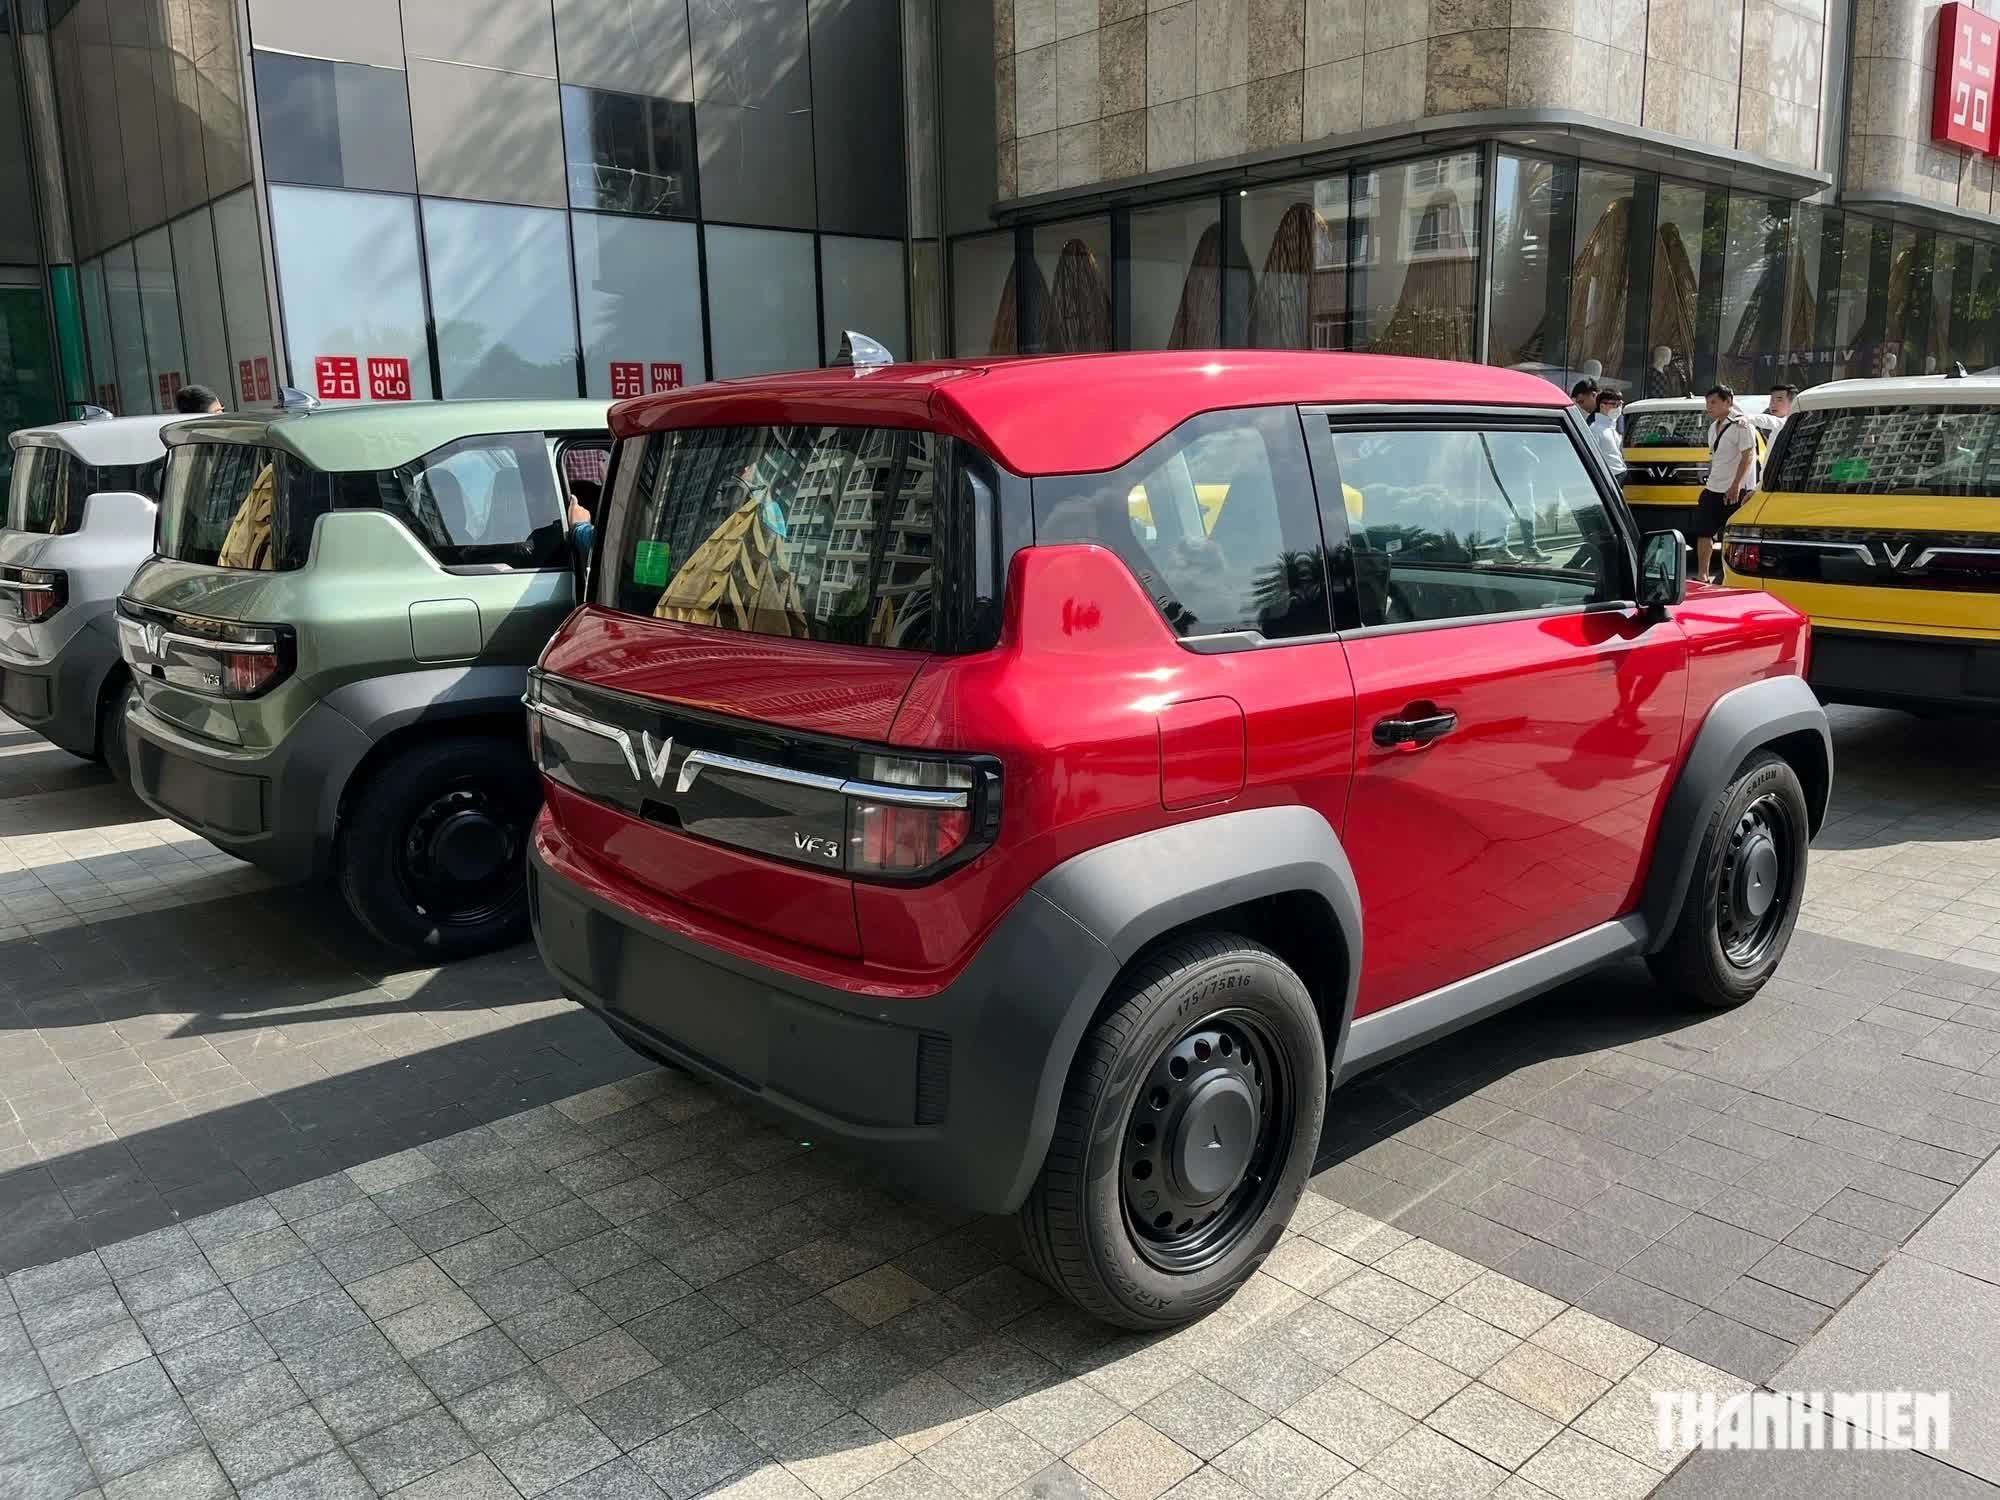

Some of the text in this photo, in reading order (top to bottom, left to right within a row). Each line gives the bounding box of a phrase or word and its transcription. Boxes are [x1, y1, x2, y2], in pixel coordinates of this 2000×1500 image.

[322, 361, 353, 377] ユニ
[372, 362, 402, 378] UNI
[654, 367, 677, 381] UNI
[374, 380, 406, 397] QLO
[1175, 975, 1252, 1017] 175/75R16
